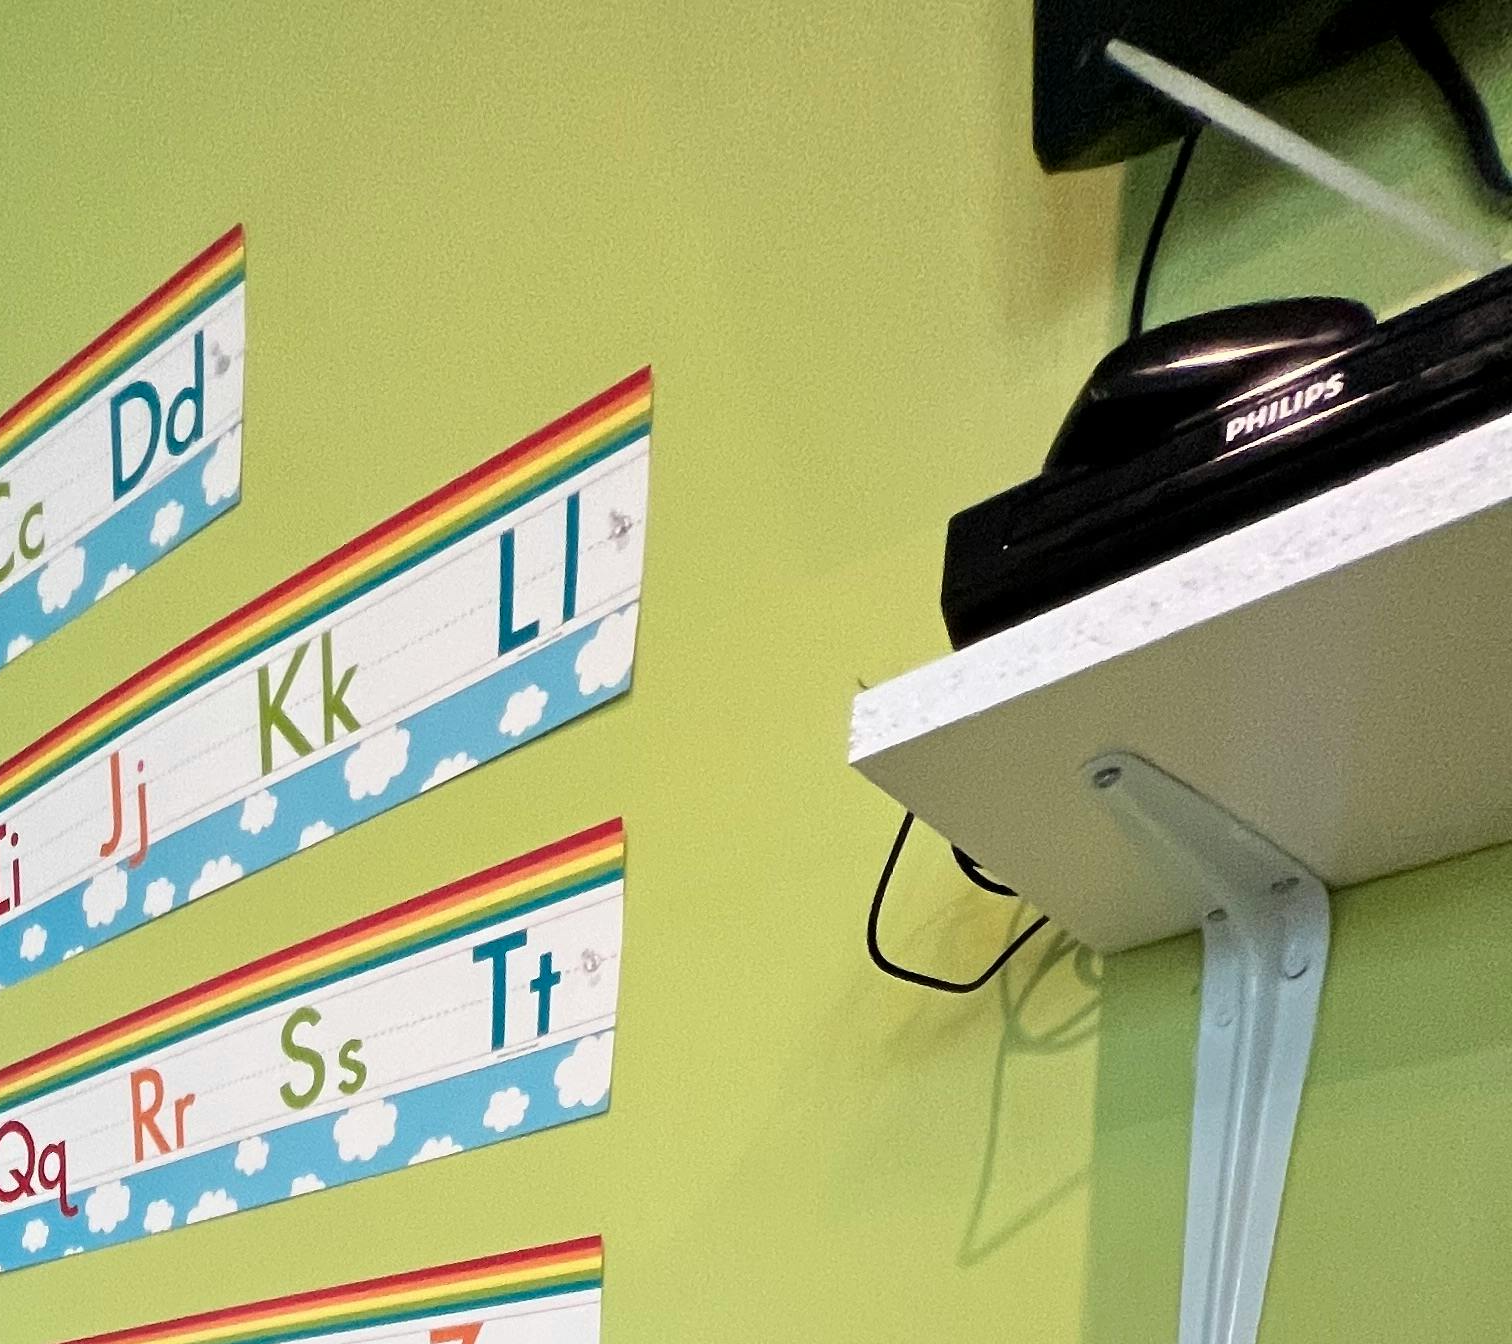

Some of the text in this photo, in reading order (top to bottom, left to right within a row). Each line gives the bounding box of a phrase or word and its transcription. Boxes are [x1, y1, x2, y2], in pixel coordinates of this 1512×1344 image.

[111, 331, 206, 501] Dd
[1225, 370, 1345, 442] PHILIPS
[100, 752, 148, 866] Jj
[257, 630, 361, 775] Kk
[131, 1069, 194, 1163] Rr
[279, 1007, 367, 1109] Ss
[473, 931, 560, 1049] Tt
